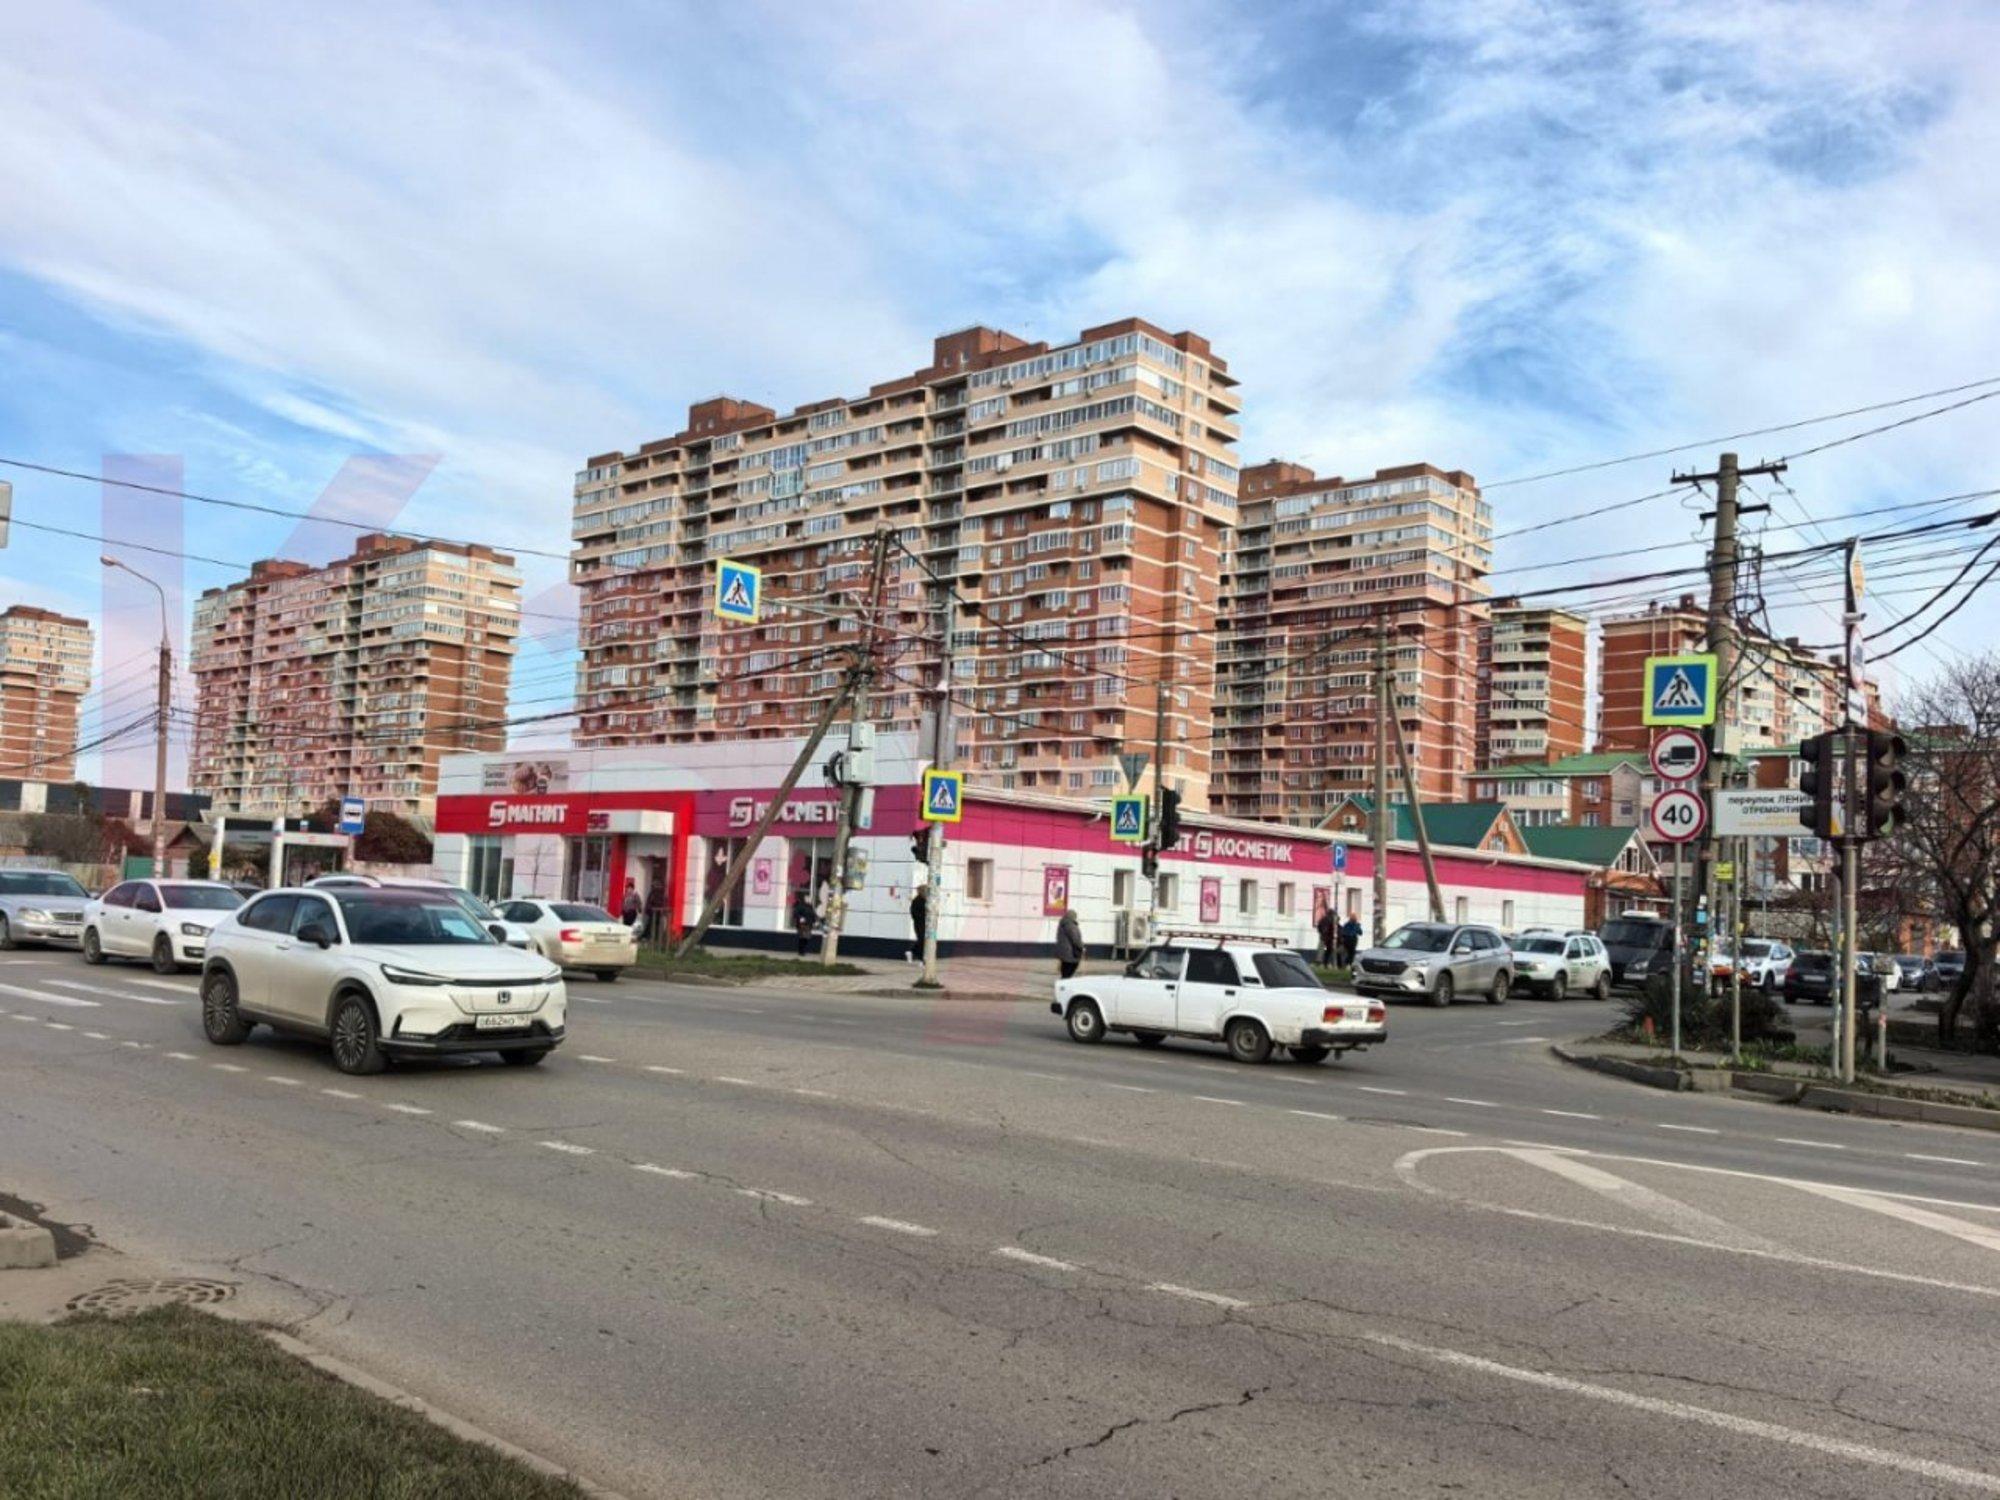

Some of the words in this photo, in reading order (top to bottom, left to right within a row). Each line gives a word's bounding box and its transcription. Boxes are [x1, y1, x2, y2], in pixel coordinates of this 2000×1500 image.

[507, 803, 568, 824] МАГНИТ
[1661, 803, 1693, 825] 40
[1214, 837, 1293, 863] КОСМЕТИК
